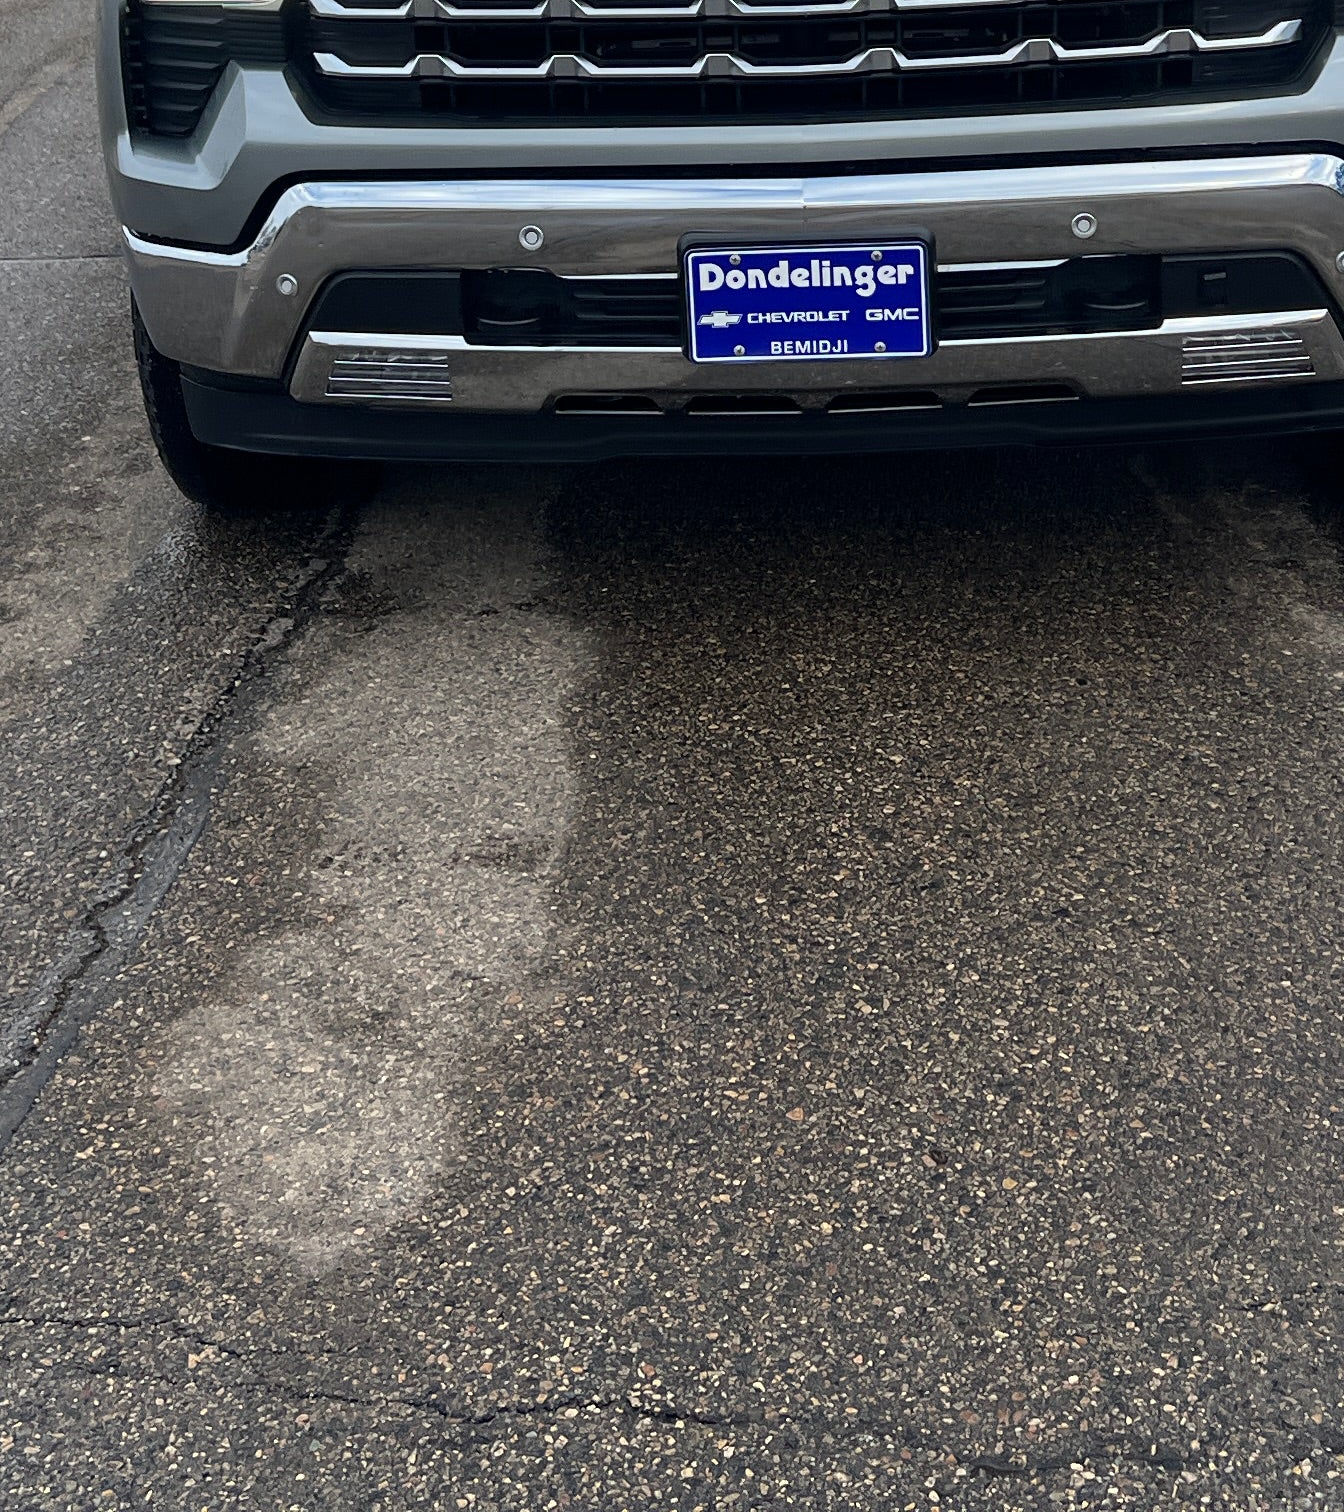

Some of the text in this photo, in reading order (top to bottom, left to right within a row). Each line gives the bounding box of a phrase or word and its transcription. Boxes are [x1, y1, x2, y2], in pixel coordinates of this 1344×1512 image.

[698, 259, 915, 297] Dondelinger
[746, 307, 920, 324] CHEVROLET GMC
[770, 339, 849, 355] BEMIDJI
